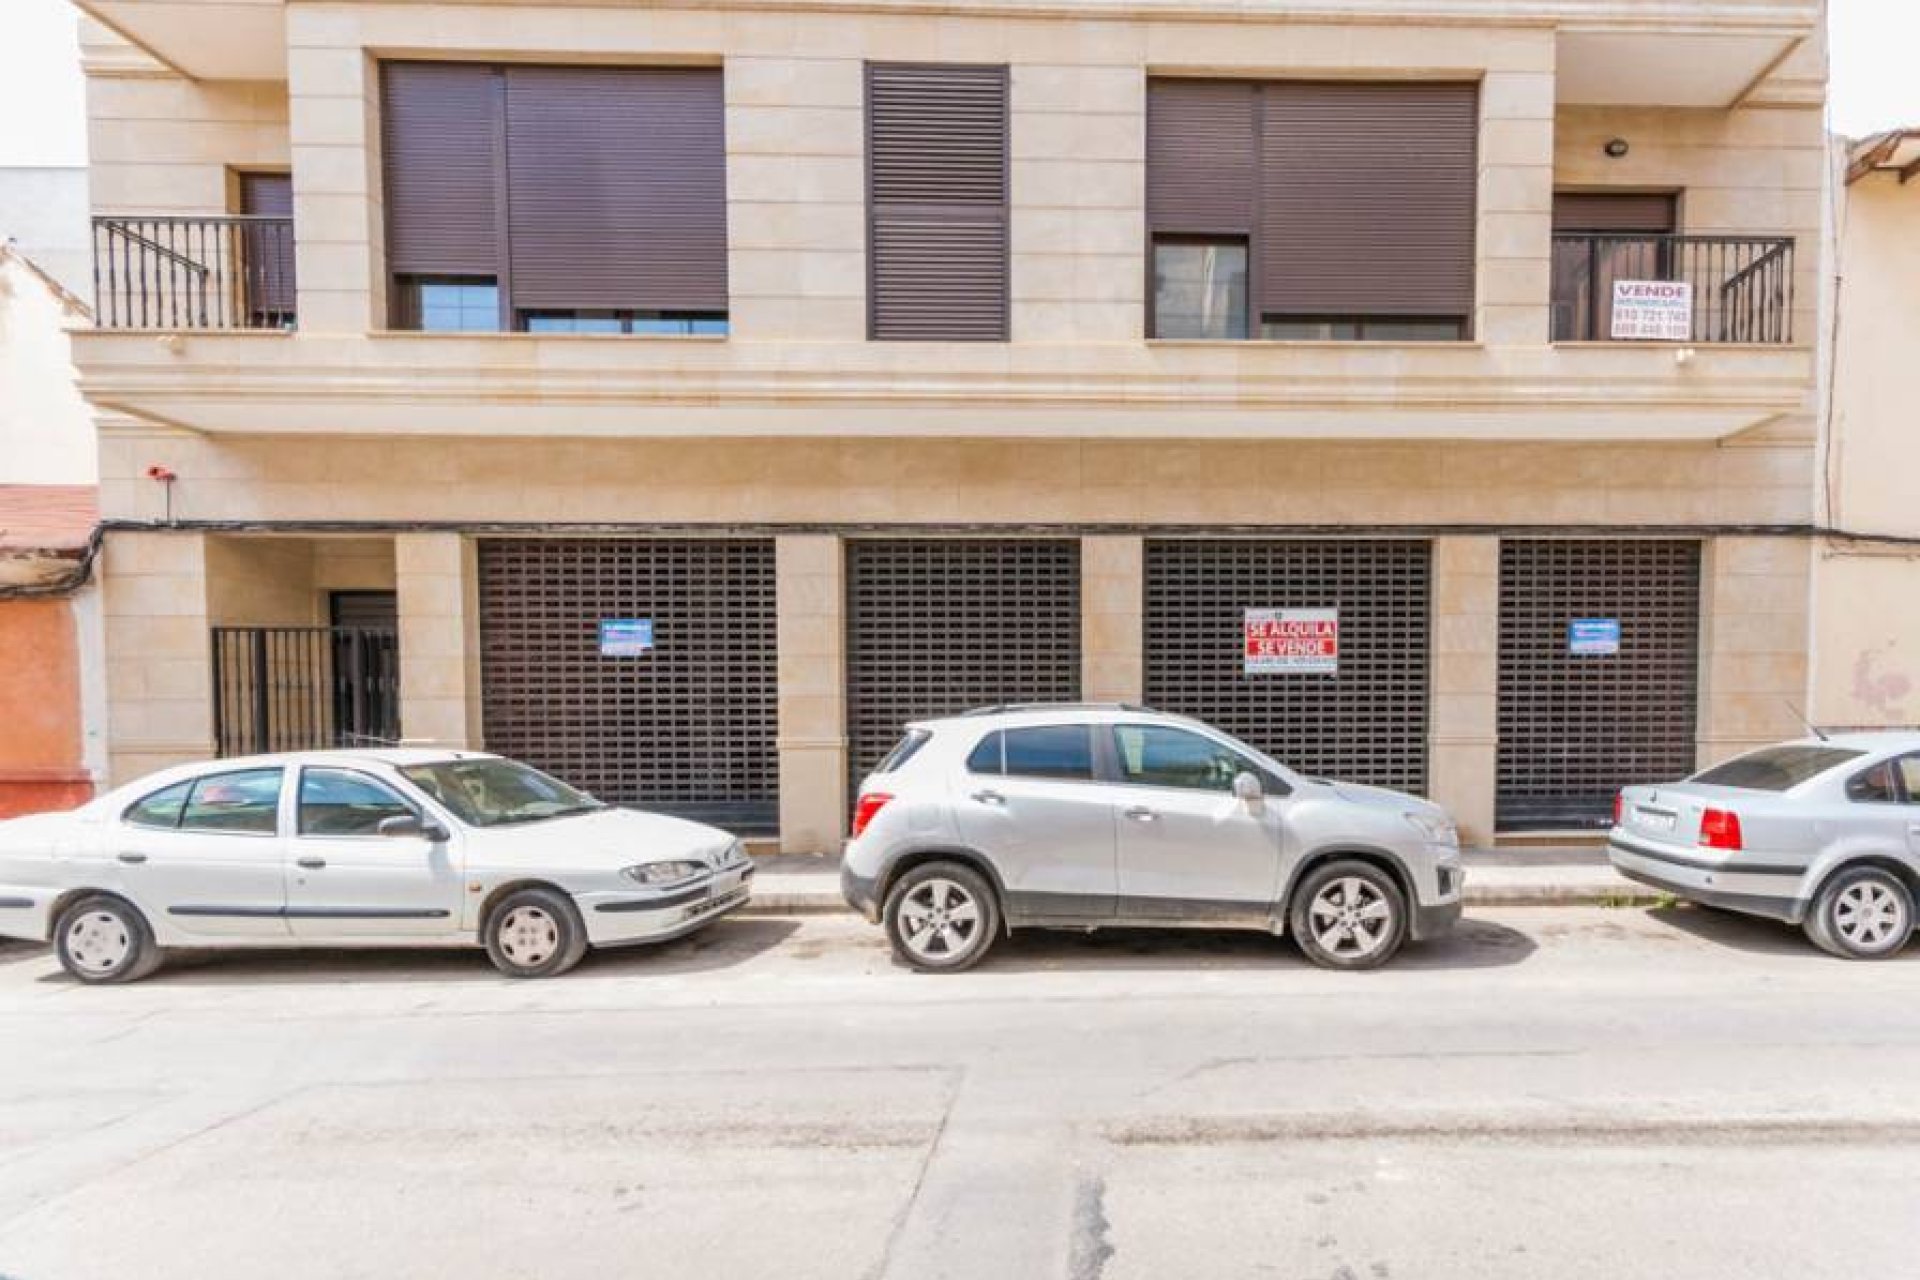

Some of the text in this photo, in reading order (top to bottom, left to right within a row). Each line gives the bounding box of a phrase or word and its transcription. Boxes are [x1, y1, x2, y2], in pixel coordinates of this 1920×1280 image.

[1618, 284, 1684, 298] VENDE
[1251, 620, 1334, 636] SE ALQUILA
[1258, 639, 1324, 654] SE VENDE
